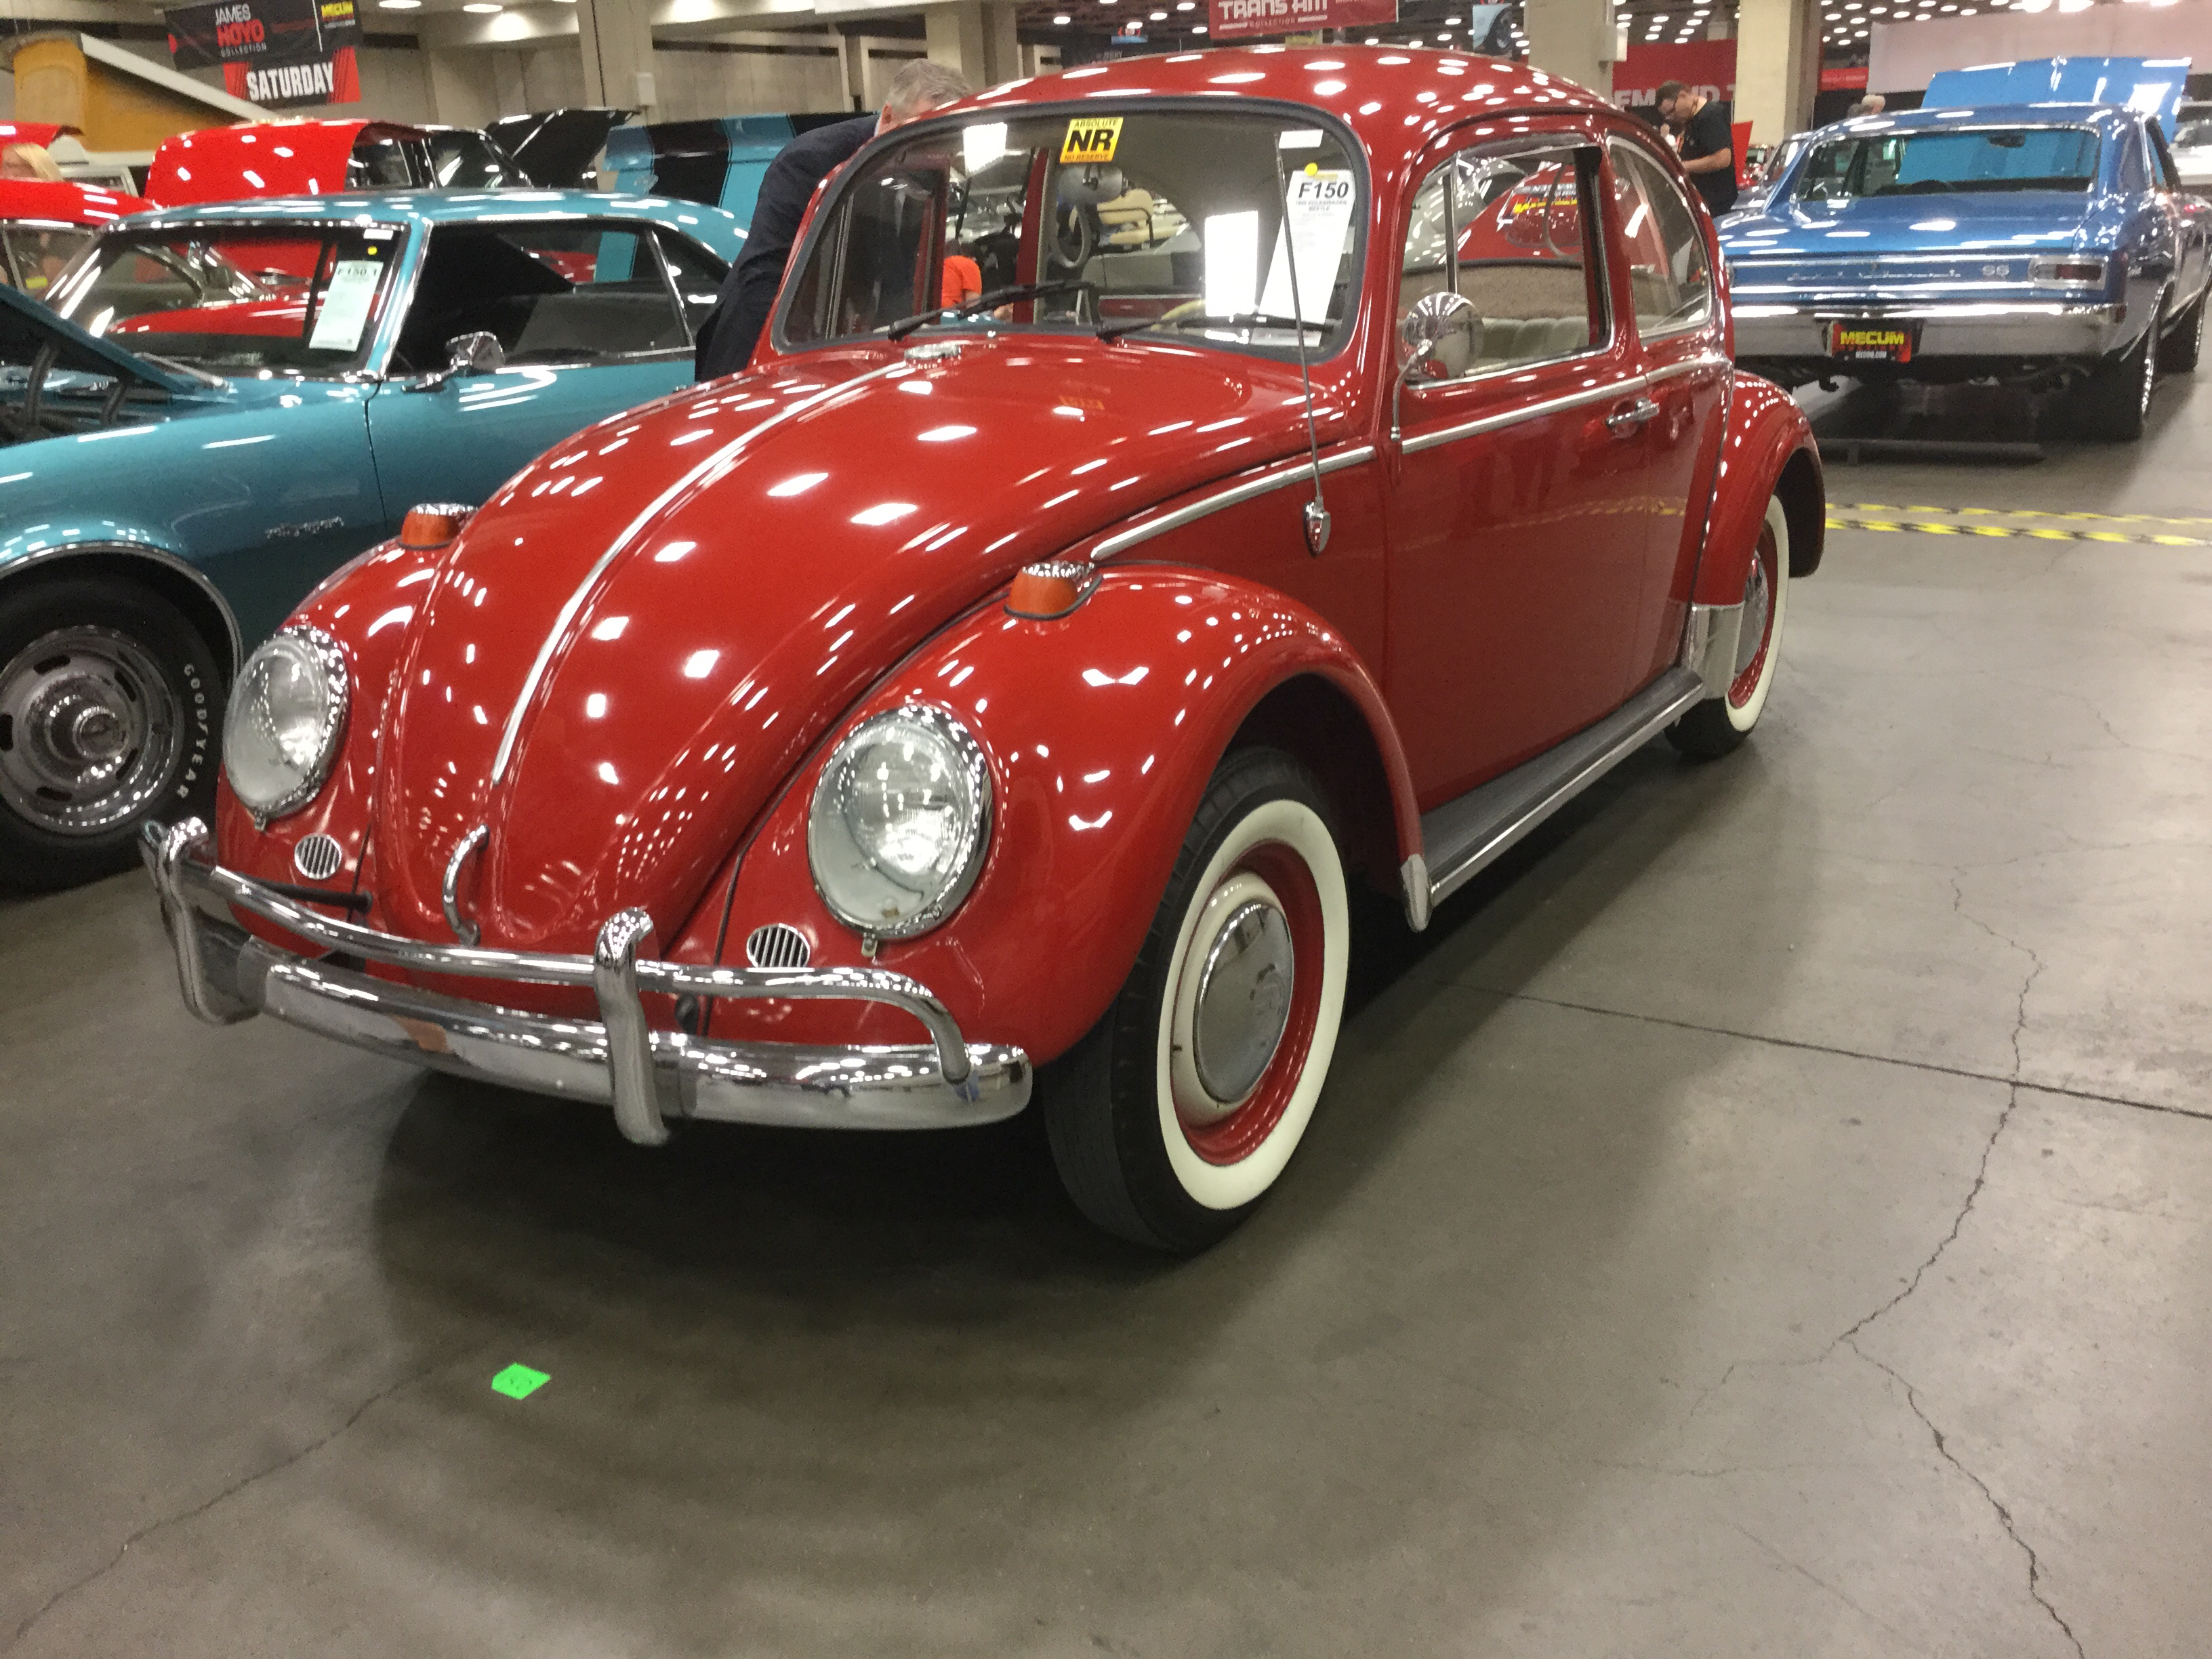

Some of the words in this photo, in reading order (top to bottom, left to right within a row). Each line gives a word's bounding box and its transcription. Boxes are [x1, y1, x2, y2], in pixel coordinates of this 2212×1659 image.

[215, 3, 251, 26] JAMES
[1218, 0, 1288, 20] TRANS
[247, 61, 334, 102] SATURDAY
[1067, 129, 1115, 152] NR
[1298, 182, 1349, 199] F150
[1840, 331, 1904, 345] MECUM
[177, 663, 209, 798] GOODYEAR
